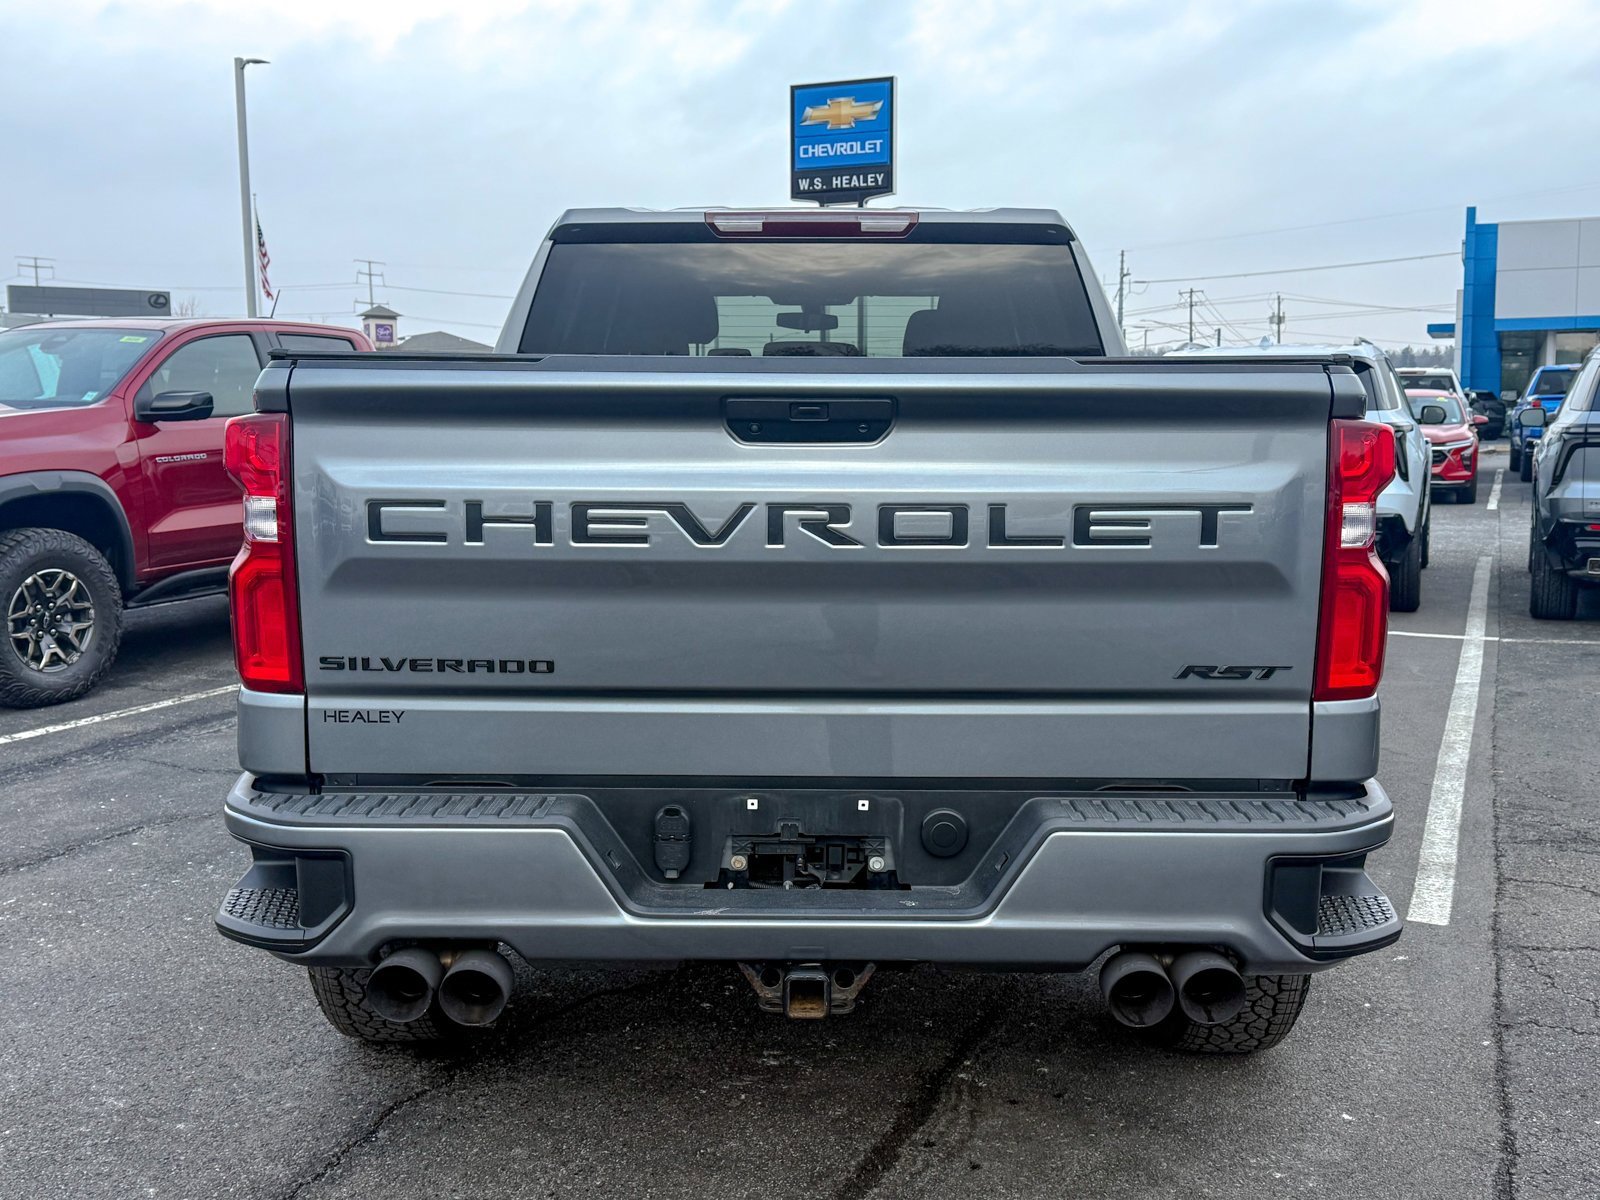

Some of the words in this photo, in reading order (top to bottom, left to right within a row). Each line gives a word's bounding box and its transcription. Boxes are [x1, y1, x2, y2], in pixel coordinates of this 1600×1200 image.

[799, 139, 884, 158] CHEVROLET
[798, 177, 827, 191] W.S.
[832, 173, 885, 189] HEALEY
[155, 452, 208, 463] COLORADO
[365, 498, 1254, 550] CHEVROLET
[319, 655, 556, 675] SILVERADO
[1172, 664, 1294, 681] RST
[323, 709, 406, 724] HEALEY
